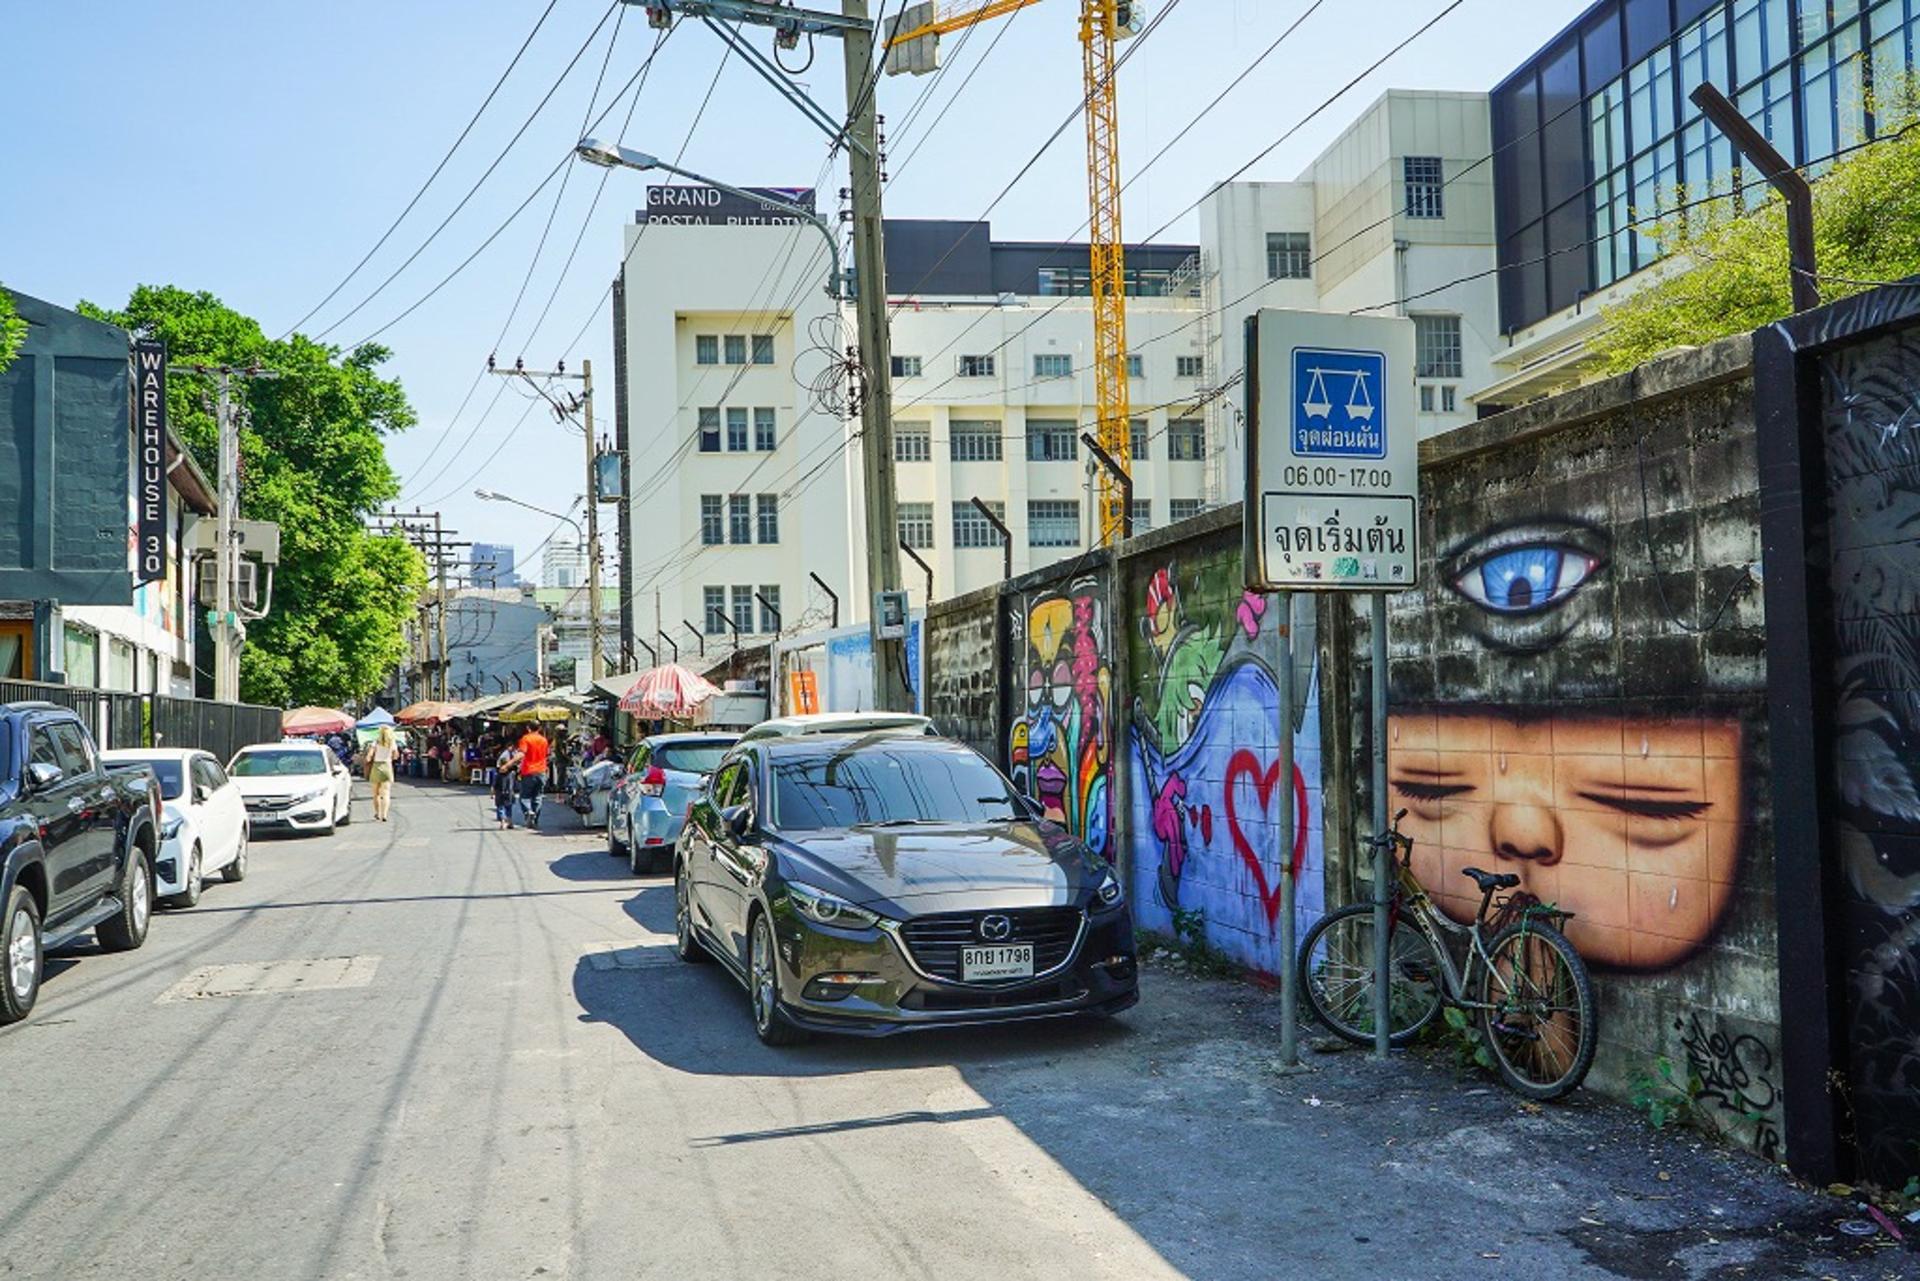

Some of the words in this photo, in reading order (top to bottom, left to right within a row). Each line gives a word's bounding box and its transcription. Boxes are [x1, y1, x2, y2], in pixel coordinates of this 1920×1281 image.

[648, 187, 721, 206] GRAND
[141, 352, 162, 521] WAREHOUSE
[1298, 424, 1380, 453] จุดผ่อนผัน
[1274, 508, 1406, 563] จุดเริ่มต้น
[145, 536, 161, 573] 30
[999, 948, 1031, 963] 1798
